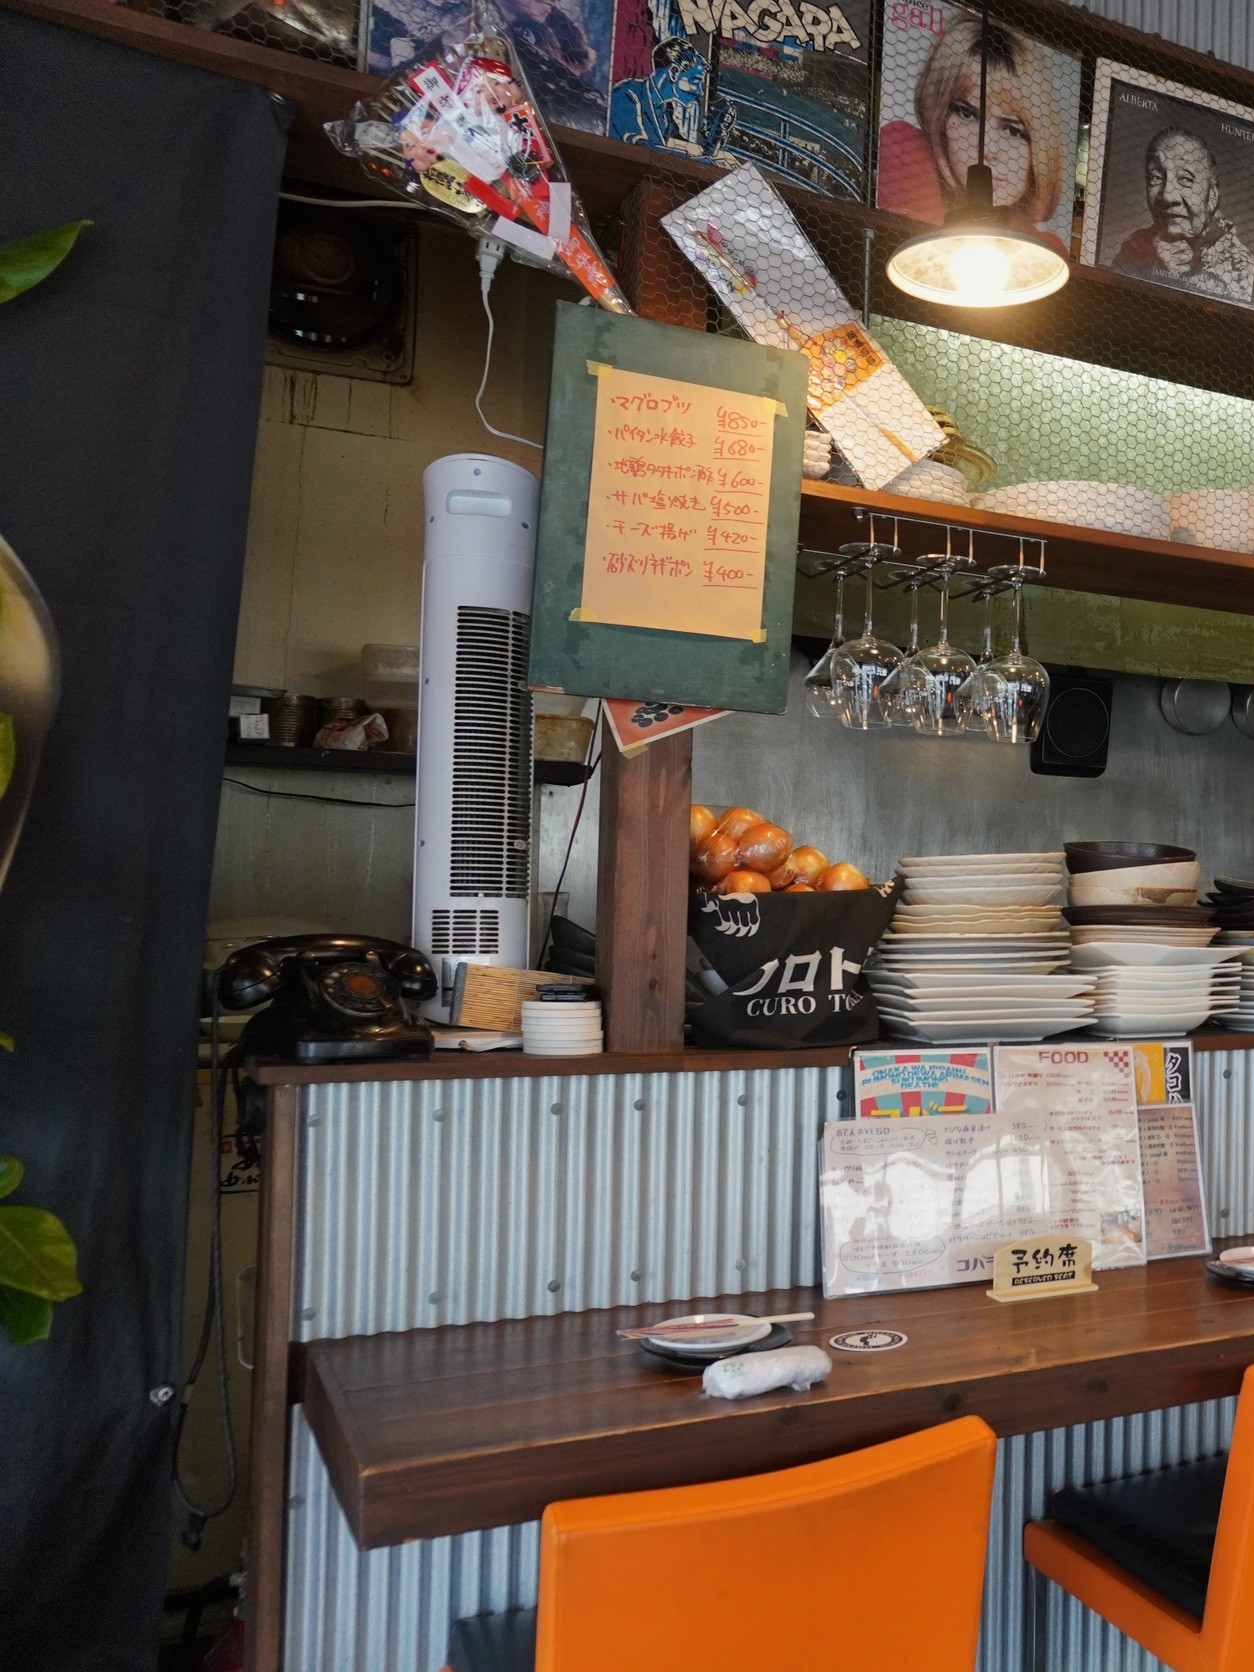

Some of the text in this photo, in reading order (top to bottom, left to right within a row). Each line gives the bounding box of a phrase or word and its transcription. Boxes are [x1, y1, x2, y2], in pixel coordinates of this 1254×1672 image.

[892, 2, 944, 37] gall
[1119, 92, 1159, 113] ALBERTA
[616, 393, 691, 414] マグロブツ
[746, 995, 817, 1017] CURO
[1038, 1051, 1090, 1064] FOOD
[1011, 1243, 1077, 1273] 予約席
[1014, 1272, 1073, 1286] RESERVED SEAT
